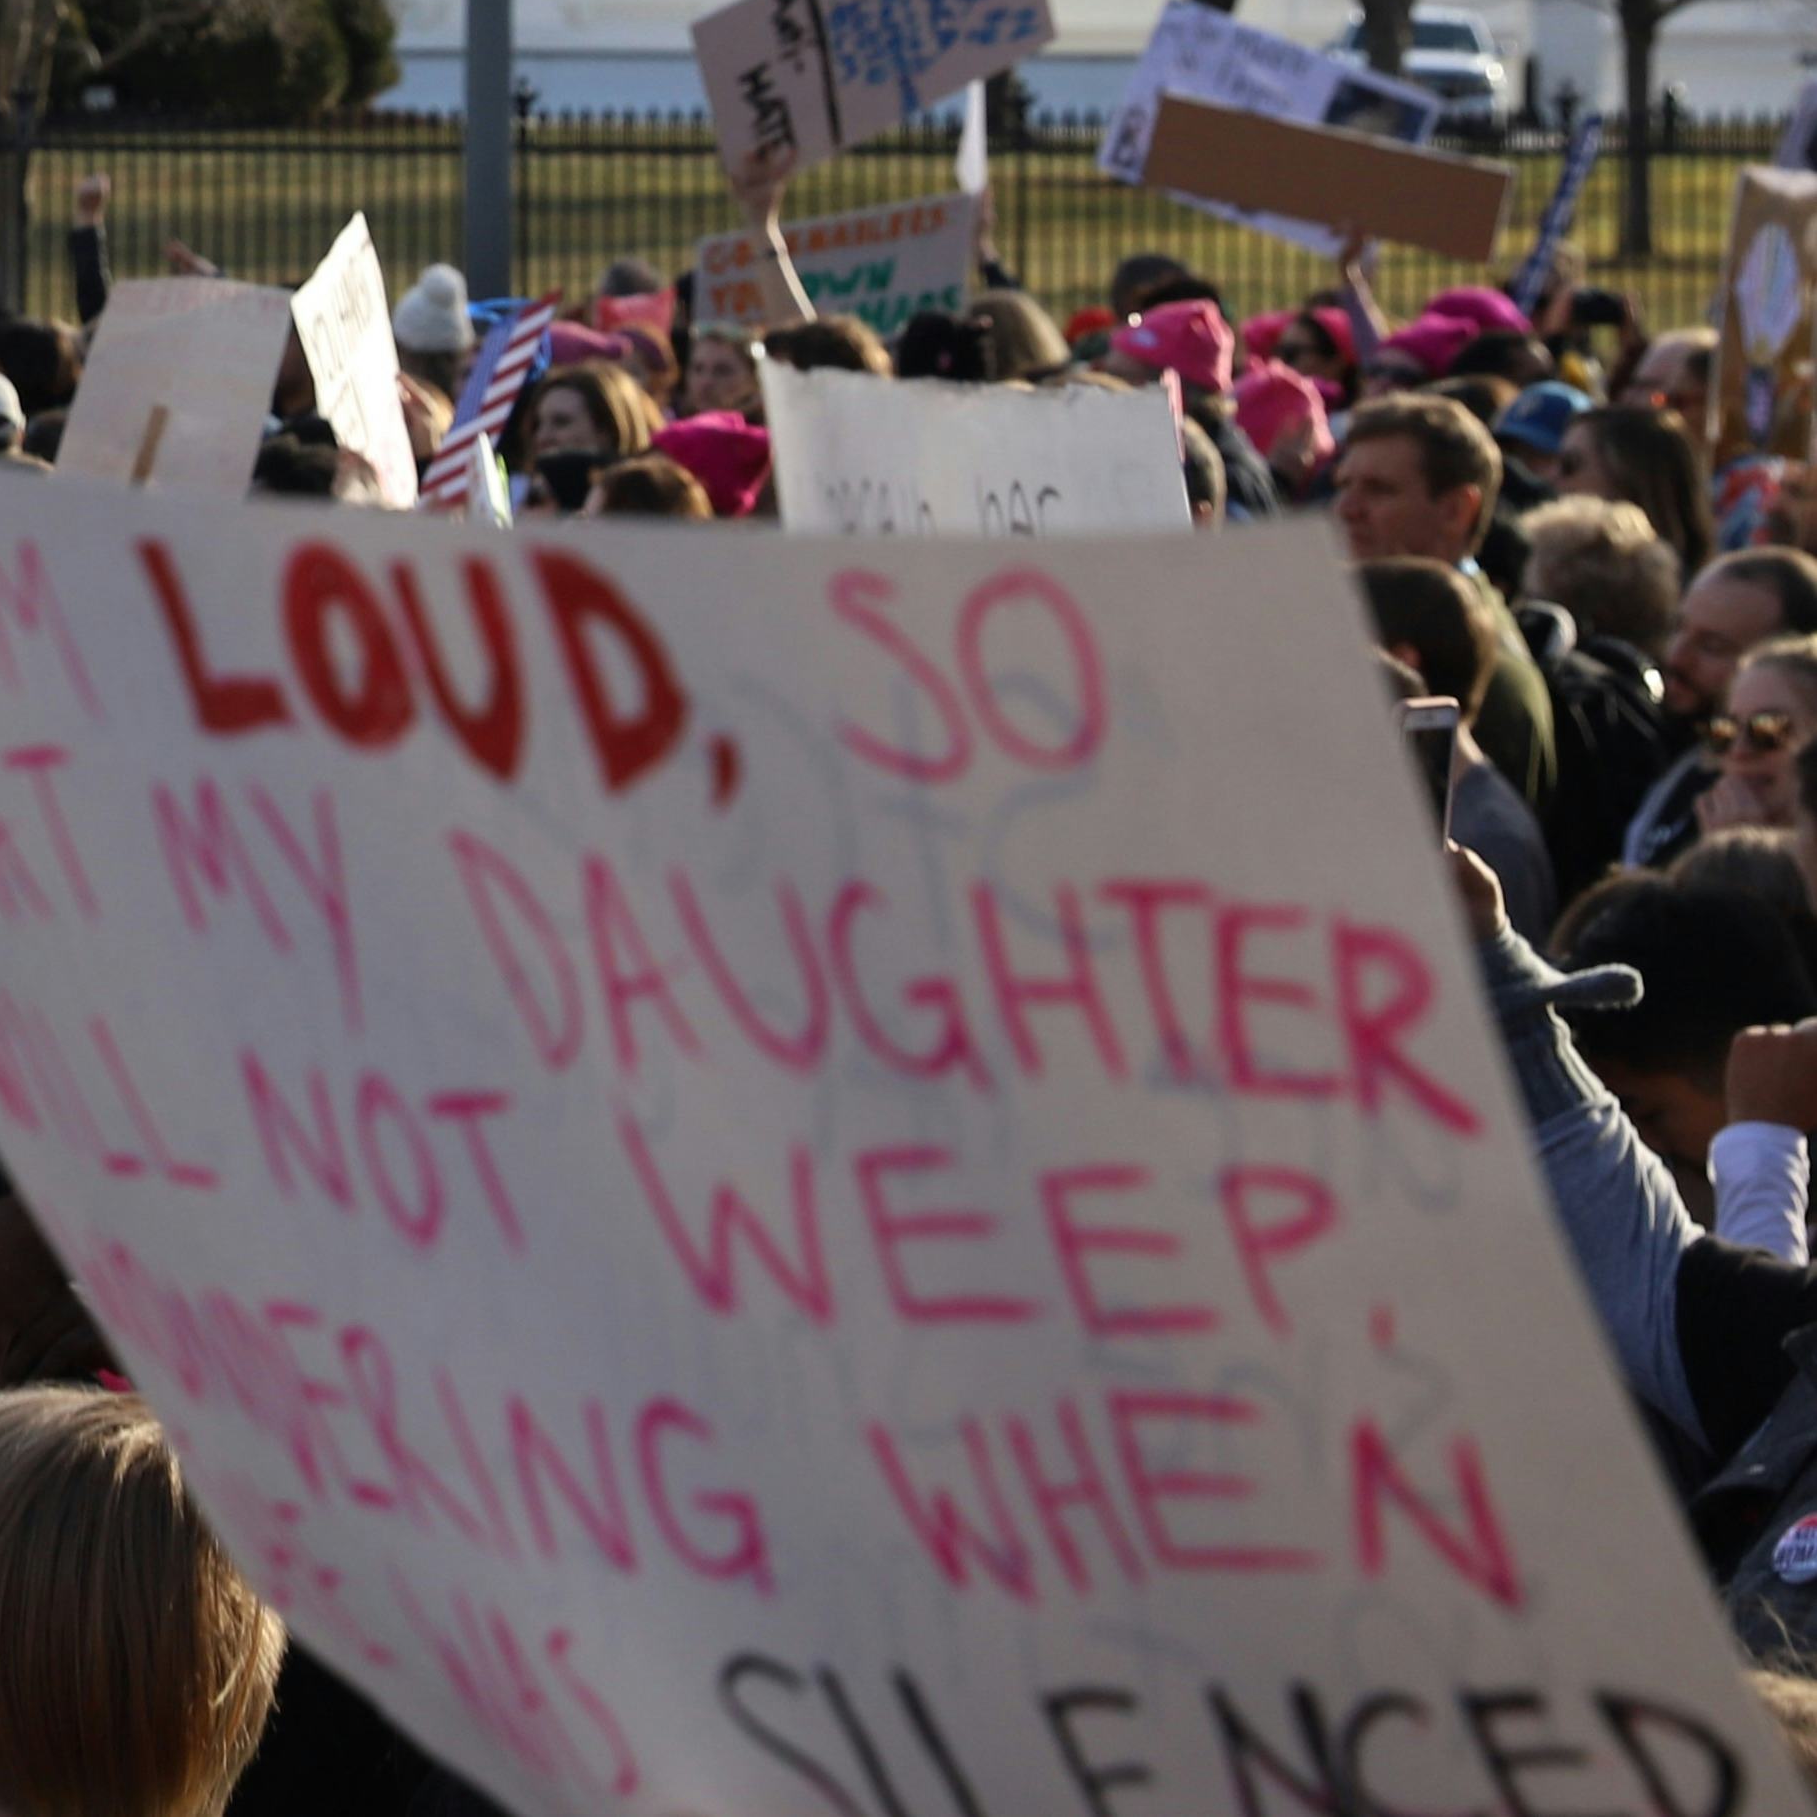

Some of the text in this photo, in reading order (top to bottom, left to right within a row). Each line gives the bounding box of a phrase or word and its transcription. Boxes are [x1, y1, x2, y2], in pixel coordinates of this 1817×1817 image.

[129, 532, 745, 812] LOUD,
[825, 562, 1111, 785] SO
[152, 770, 369, 1042] MY
[445, 825, 1487, 1139] DAUGHTER
[236, 1044, 530, 1258] NOT
[863, 1388, 1528, 1612] WHEN
